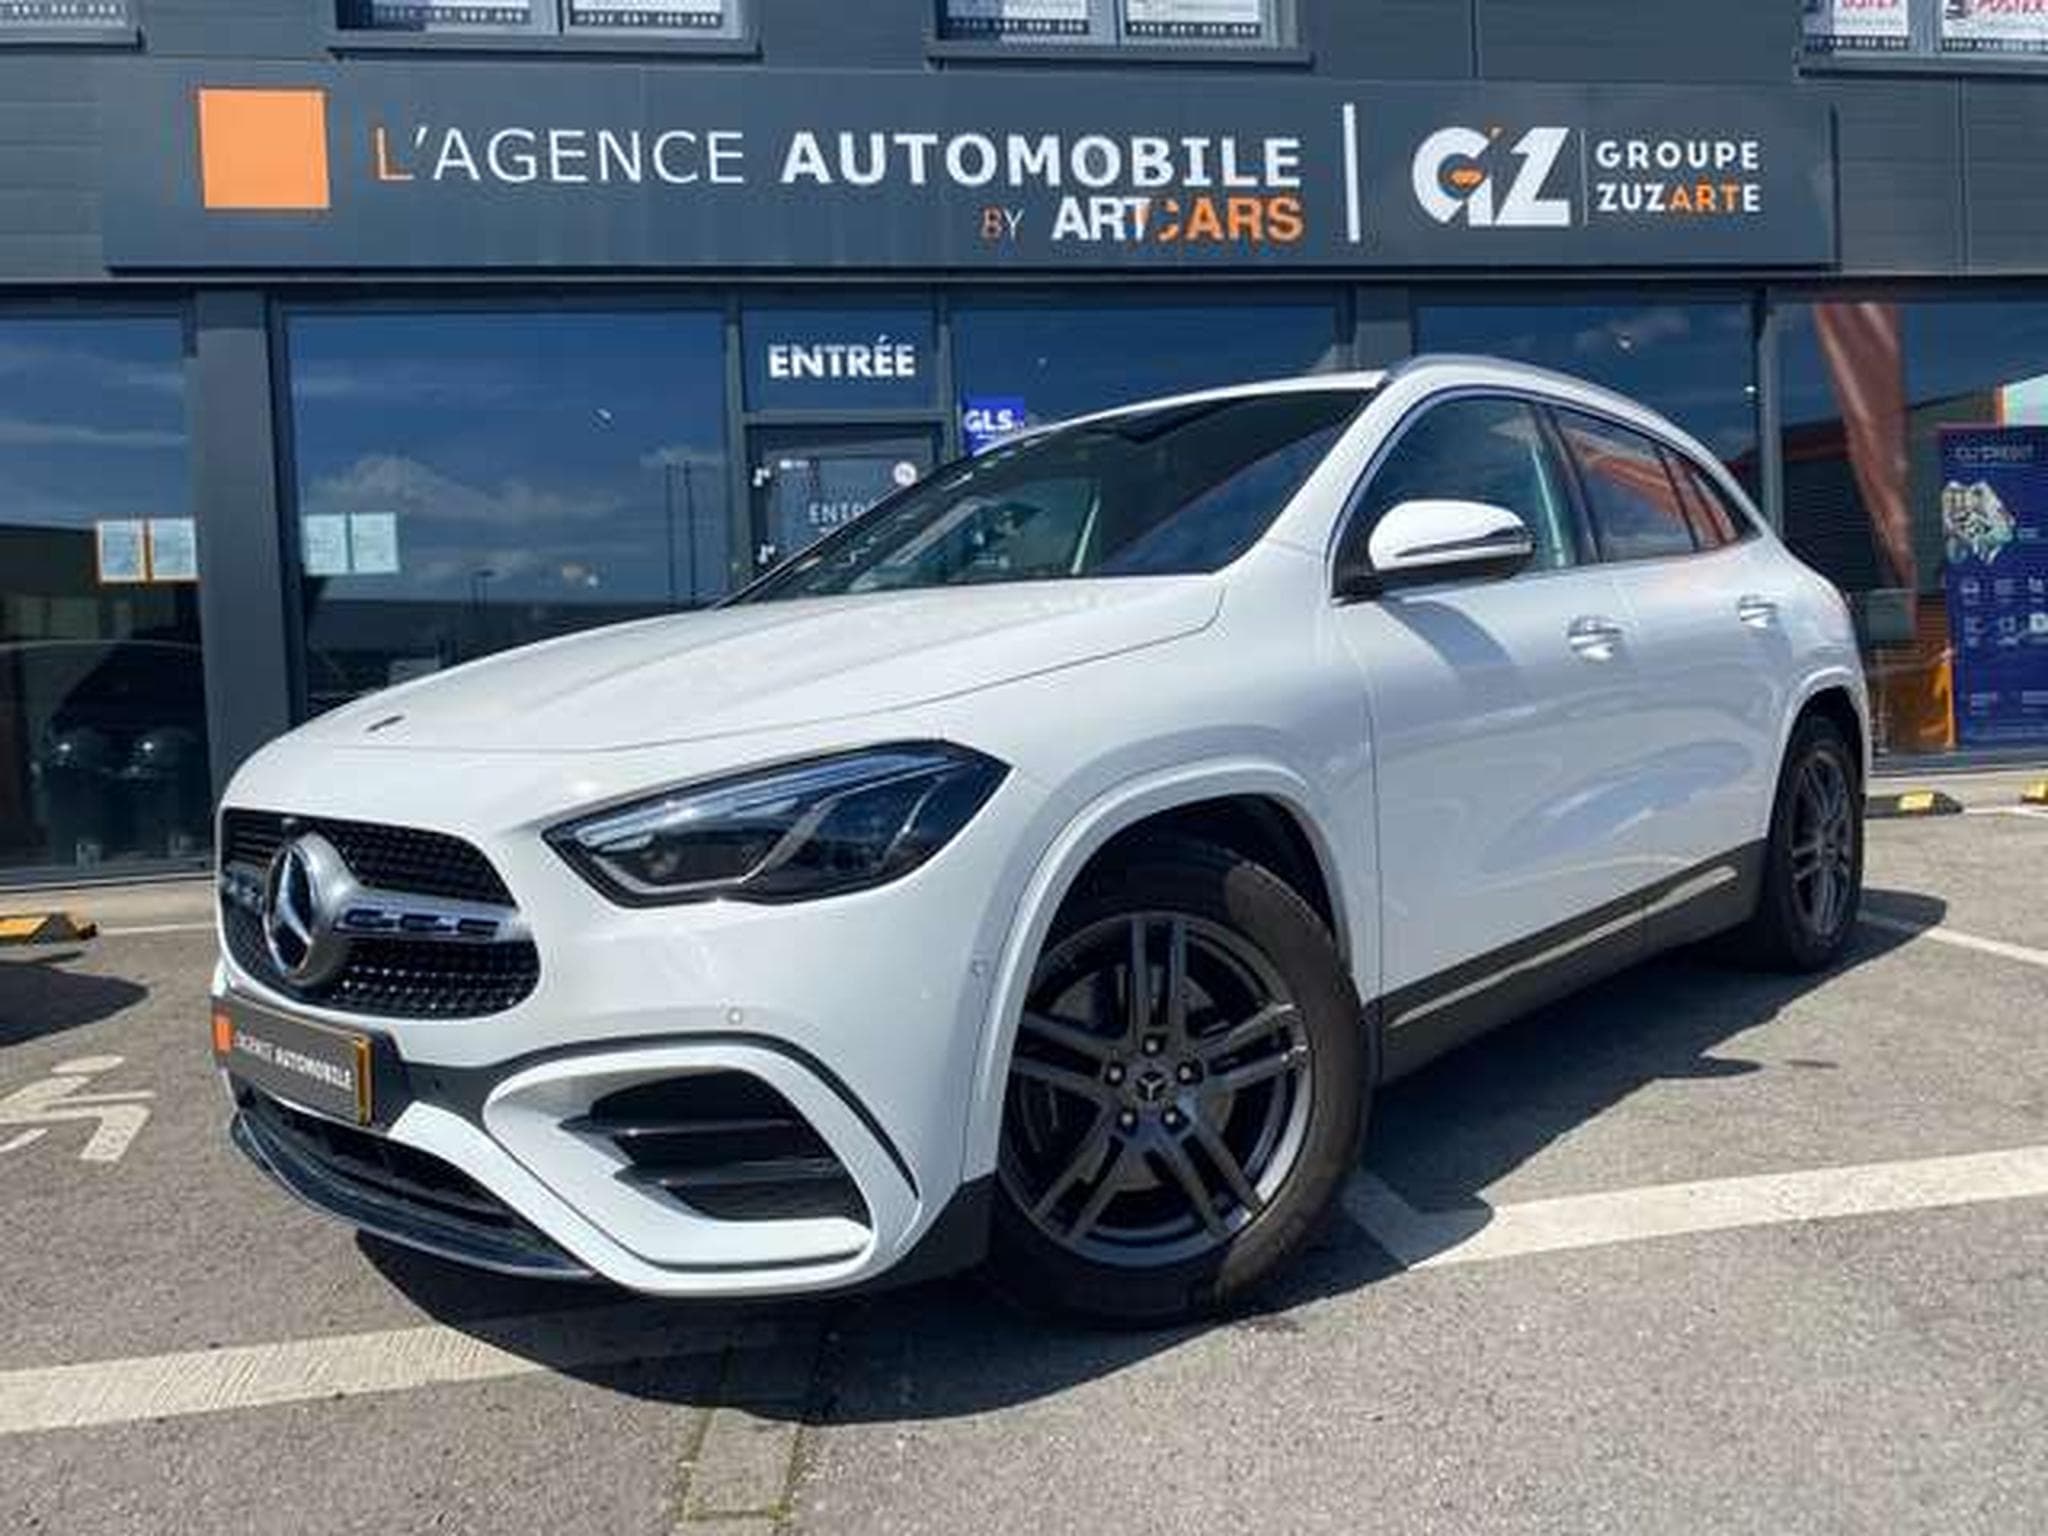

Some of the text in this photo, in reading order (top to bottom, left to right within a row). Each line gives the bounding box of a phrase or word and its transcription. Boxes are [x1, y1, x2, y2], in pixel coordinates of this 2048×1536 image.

[373, 126, 1301, 188] L'AGENCE AUTOMOBILE
[1596, 140, 1760, 170] GROUPE
[1596, 183, 1762, 212] ZUZARTE
[980, 196, 1304, 243] BY ARTCARS
[768, 334, 916, 378] ENTRÉE
[964, 409, 1014, 432] GLS
